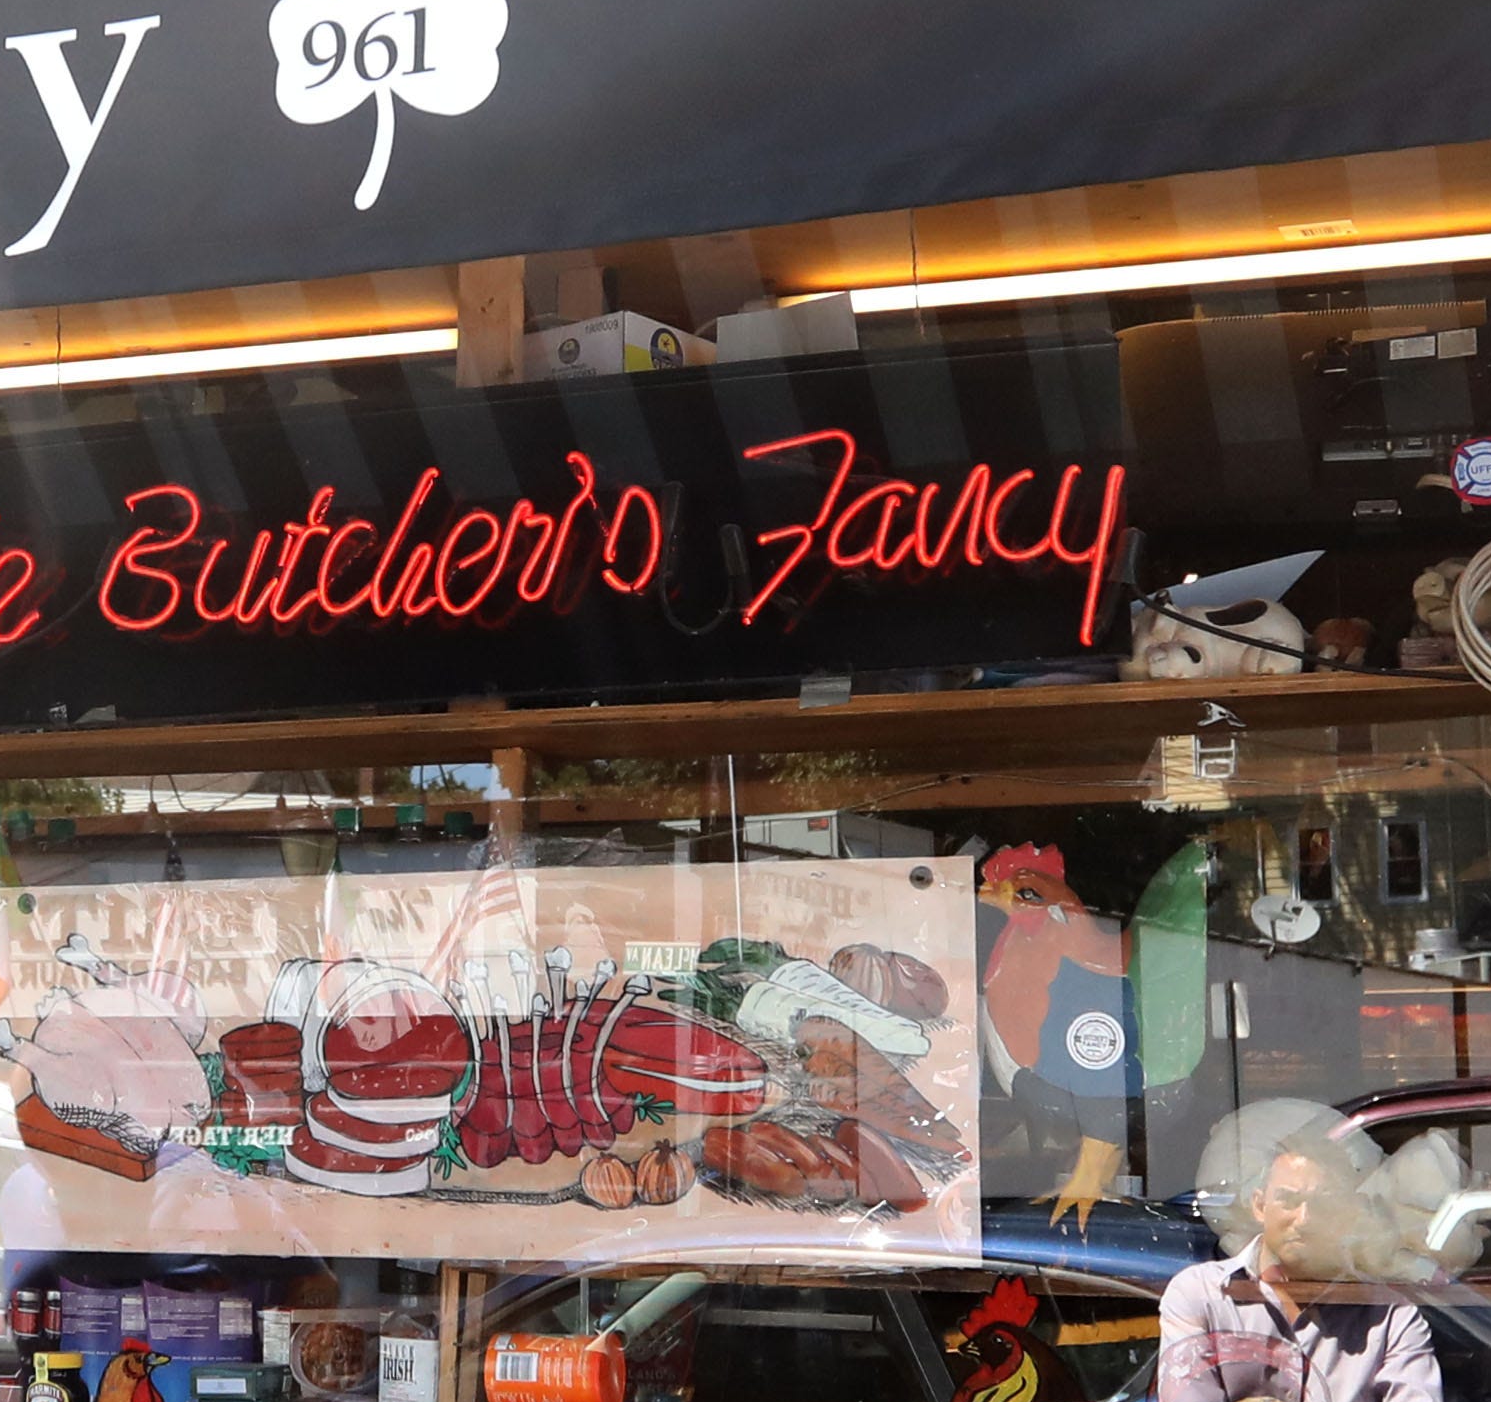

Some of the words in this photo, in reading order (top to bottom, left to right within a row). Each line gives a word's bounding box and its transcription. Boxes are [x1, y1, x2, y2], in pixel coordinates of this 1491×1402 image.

[301, 4, 438, 88] 961
[96, 449, 664, 633] Butcher's
[740, 426, 1125, 649] Fancy
